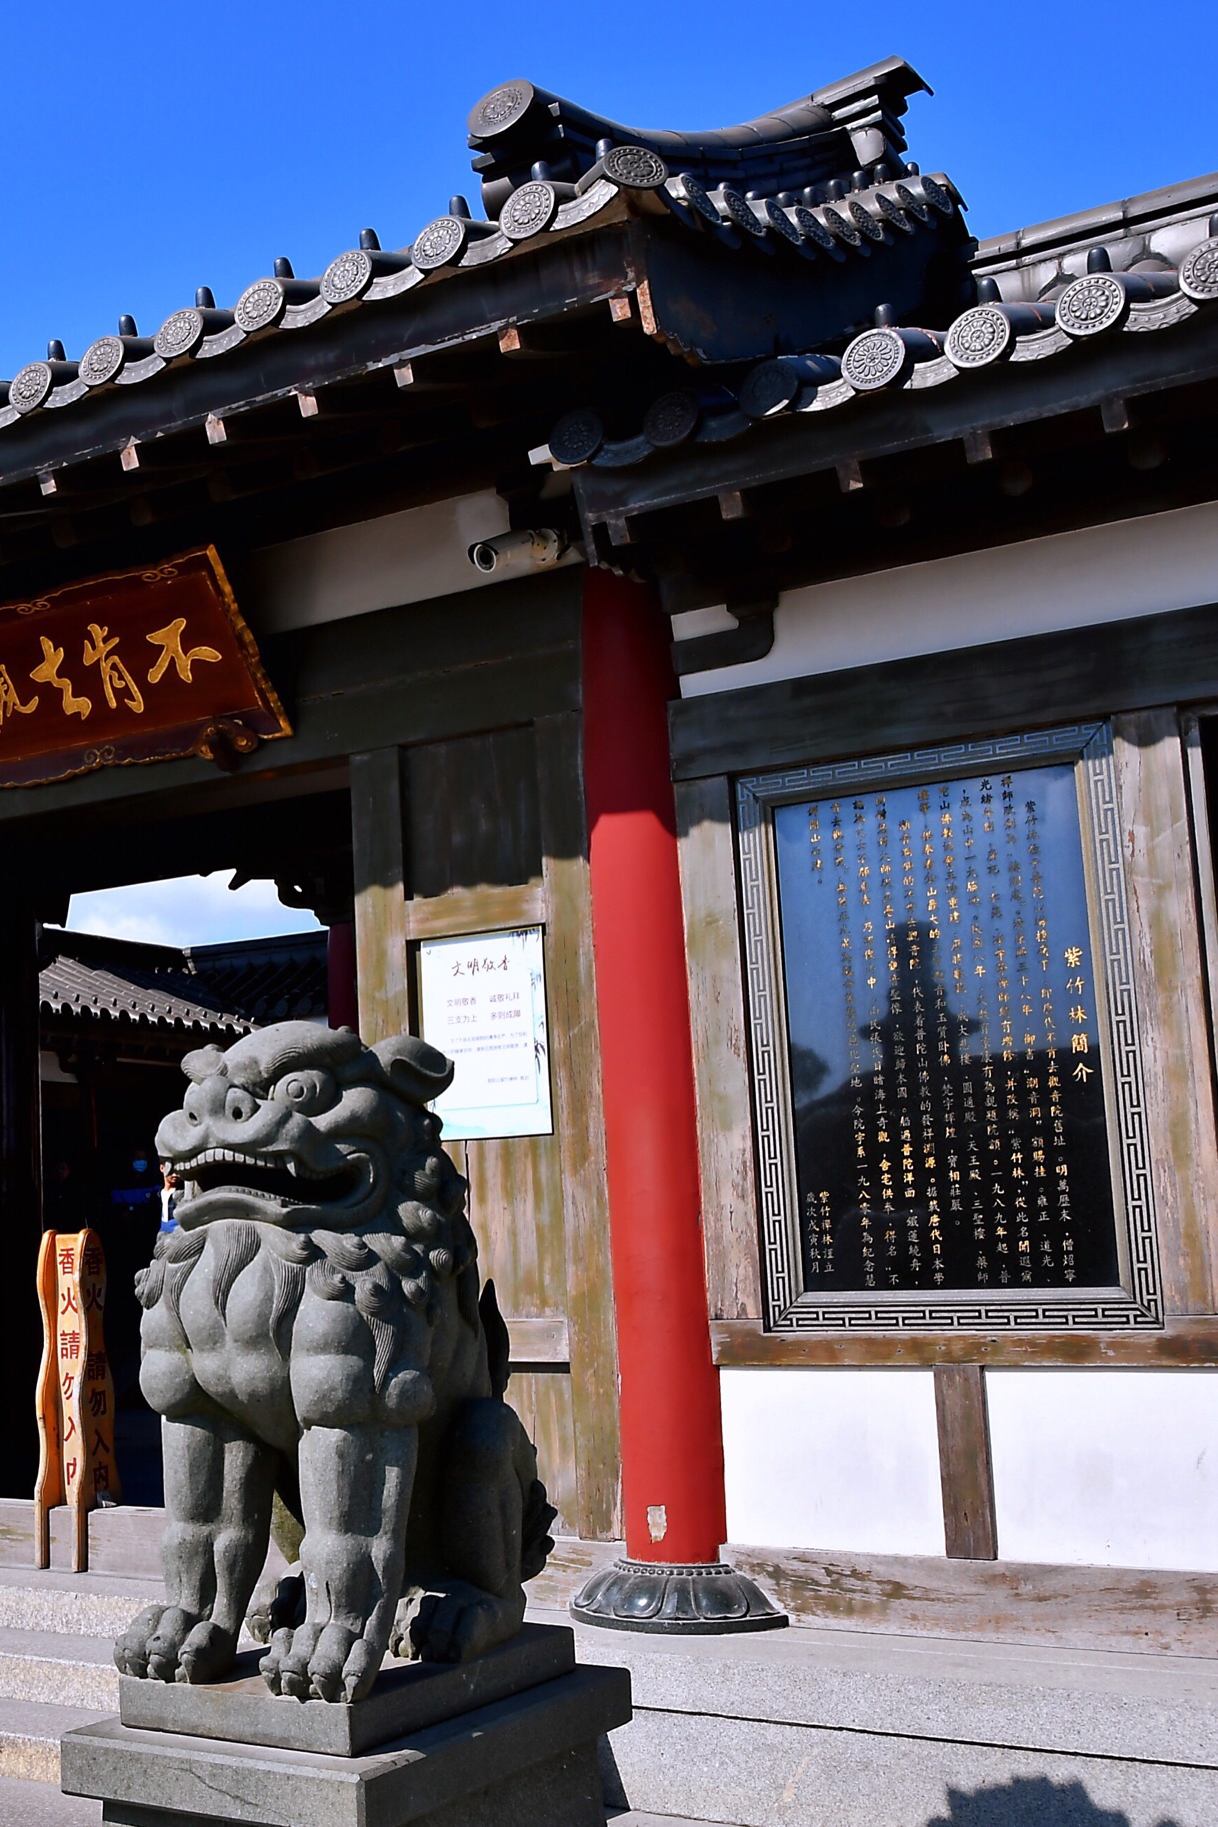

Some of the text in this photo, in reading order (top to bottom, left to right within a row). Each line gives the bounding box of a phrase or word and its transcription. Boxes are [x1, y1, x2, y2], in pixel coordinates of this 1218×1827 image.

[1063, 947, 1093, 1083] 紫竹林簡介
